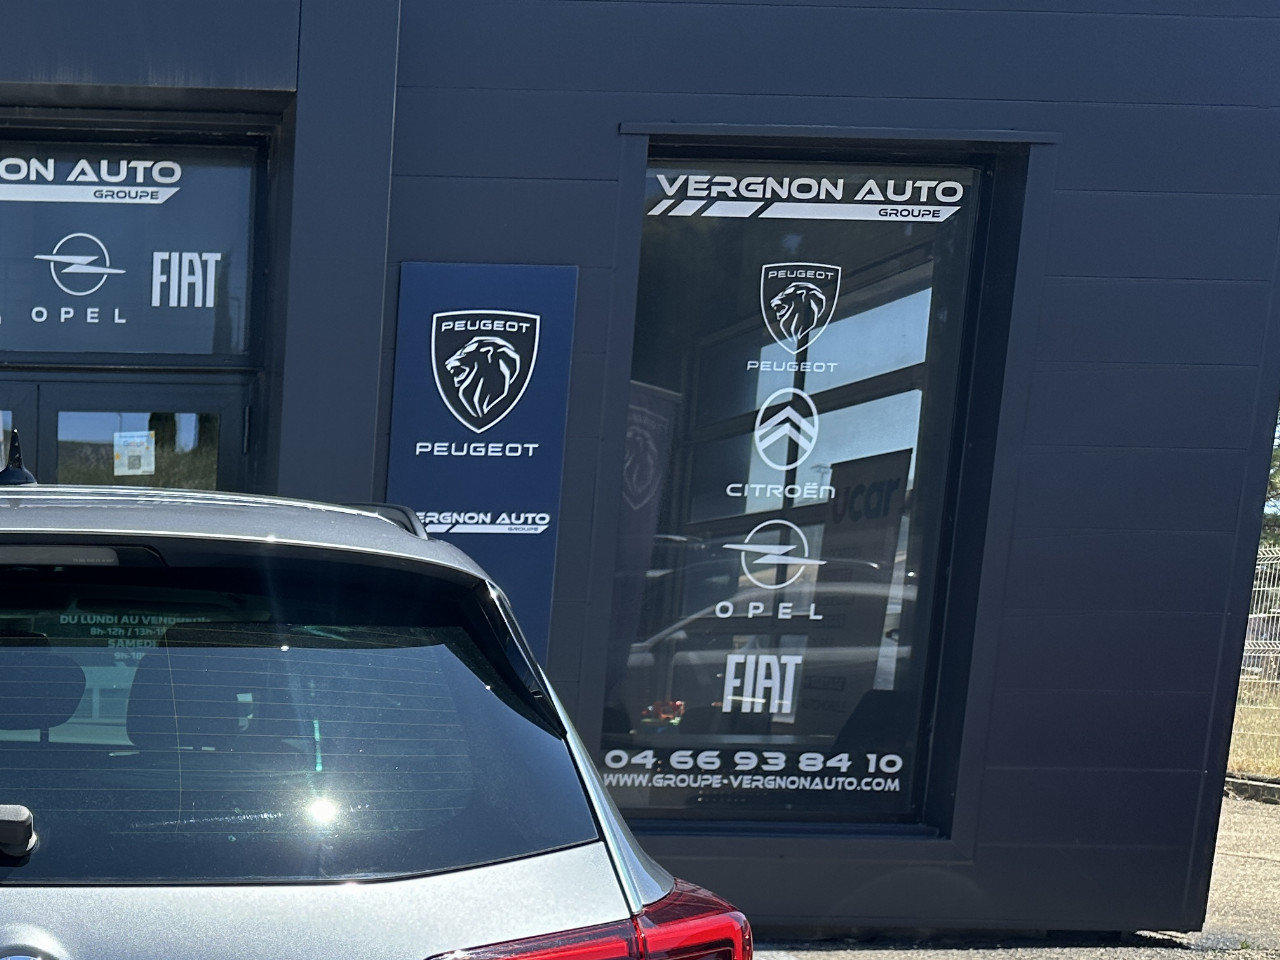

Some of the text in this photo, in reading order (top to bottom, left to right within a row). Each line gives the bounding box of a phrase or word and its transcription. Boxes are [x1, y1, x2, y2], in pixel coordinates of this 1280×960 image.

[66, 159, 182, 185] AUTO
[93, 189, 160, 201] GROUPE
[655, 174, 964, 203] VERGNON AUTO
[878, 207, 941, 219] GROUPE
[150, 251, 221, 308] FIAT
[767, 269, 835, 280] PEUGEOT
[31, 306, 127, 324] OPEL
[440, 319, 531, 334] PEUGEOT
[746, 360, 838, 373] PEUGEOT
[415, 442, 540, 457] PEUGEOT
[415, 512, 550, 525] ERGNON AUTO
[715, 600, 824, 621] OPEL
[60, 615, 78, 624] DU
[81, 615, 118, 624] LUNDI
[120, 615, 139, 625] AU
[721, 654, 803, 714] FIAT
[604, 749, 904, 773] 04 66 93 84 10
[603, 773, 900, 792] WWW.GROUPE-VERGNONAUTO.COM
